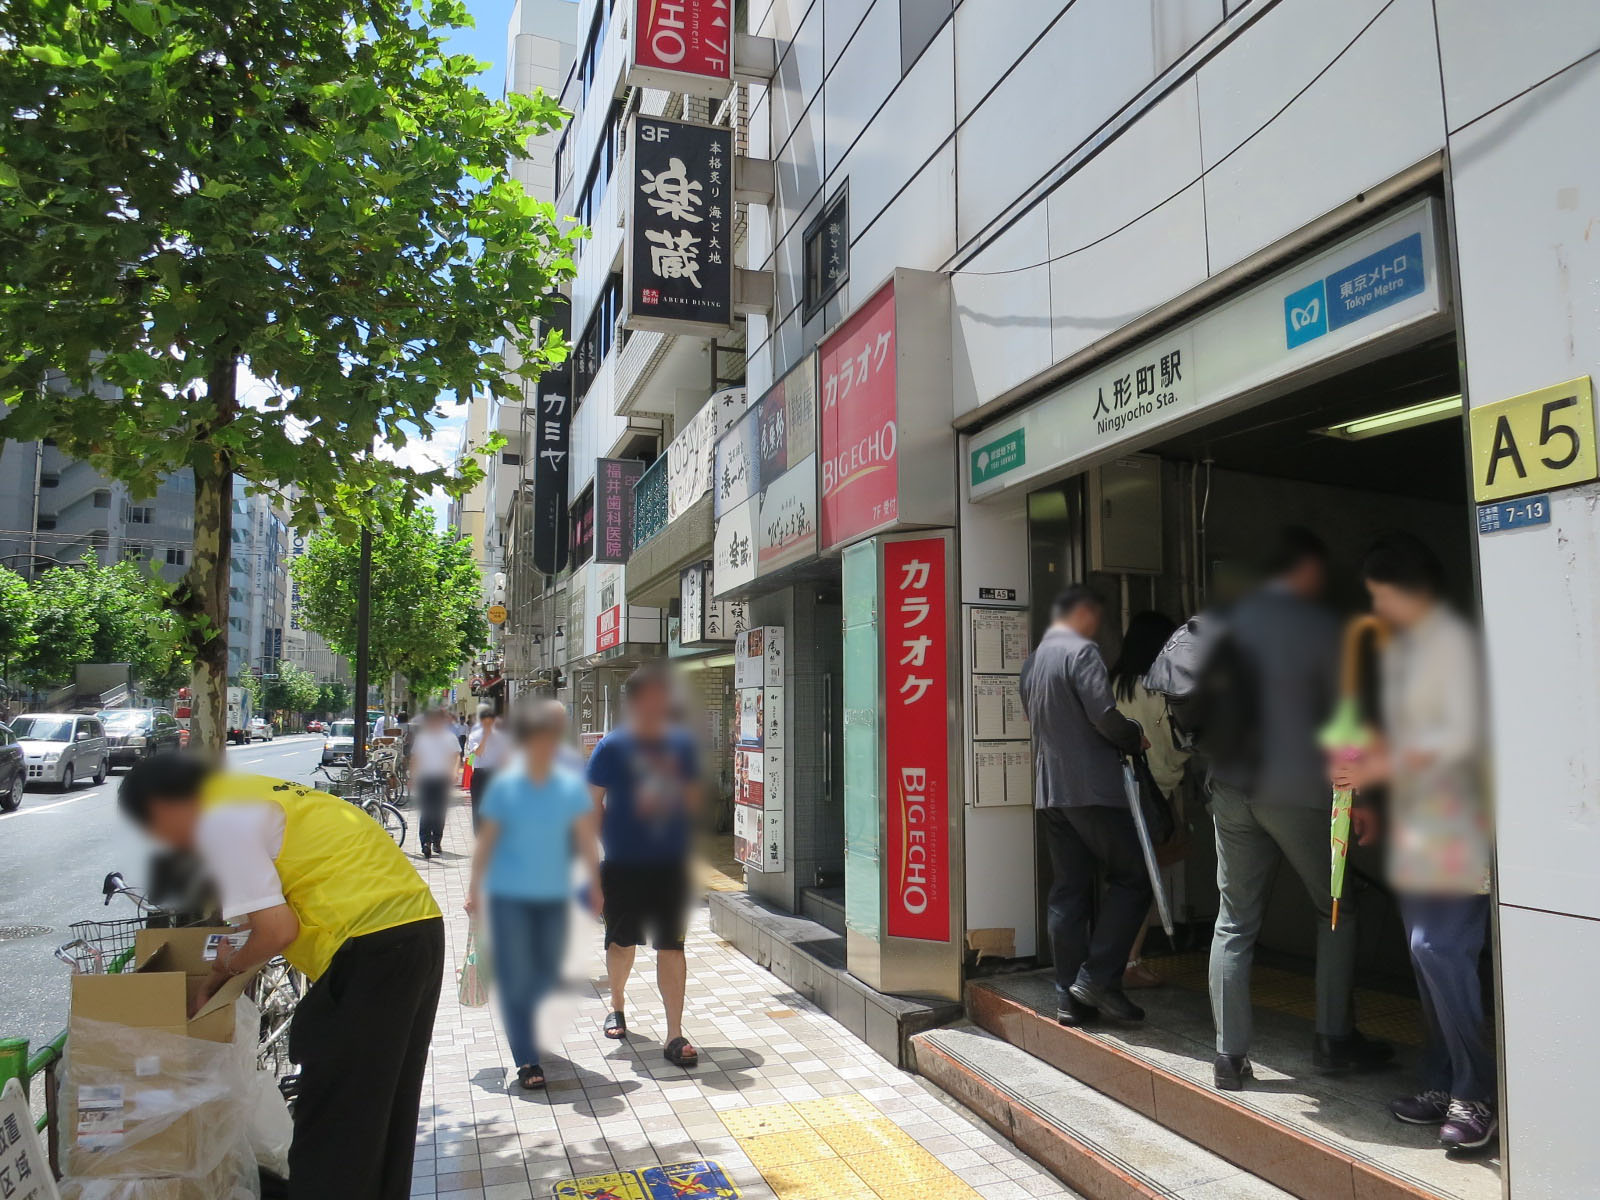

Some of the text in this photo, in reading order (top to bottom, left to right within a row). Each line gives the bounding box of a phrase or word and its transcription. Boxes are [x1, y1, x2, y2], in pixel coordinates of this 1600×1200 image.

[652, 0, 686, 64] HO
[705, 38, 727, 72] 7F
[641, 125, 670, 143] 3F
[640, 157, 704, 289] 楽蔵
[708, 140, 722, 265] 本格炙り 海と大地
[692, 299, 721, 308] DINING
[1340, 255, 1407, 300] 東京メトロ
[1344, 278, 1404, 310] Tokyo Metro
[824, 330, 892, 412] カラオケ
[1093, 349, 1182, 420] 人形町駅
[540, 393, 567, 472] カミヤ
[1097, 391, 1178, 434] Ningyocho Sta.
[1485, 396, 1580, 486] A5
[822, 421, 897, 498] BIG ECHO
[606, 463, 621, 557] 福井歯科医院
[1506, 502, 1543, 522] 7-13
[899, 559, 933, 706] カラオケ
[582, 694, 592, 733] 人形町
[902, 768, 928, 914] BIG ECHO
